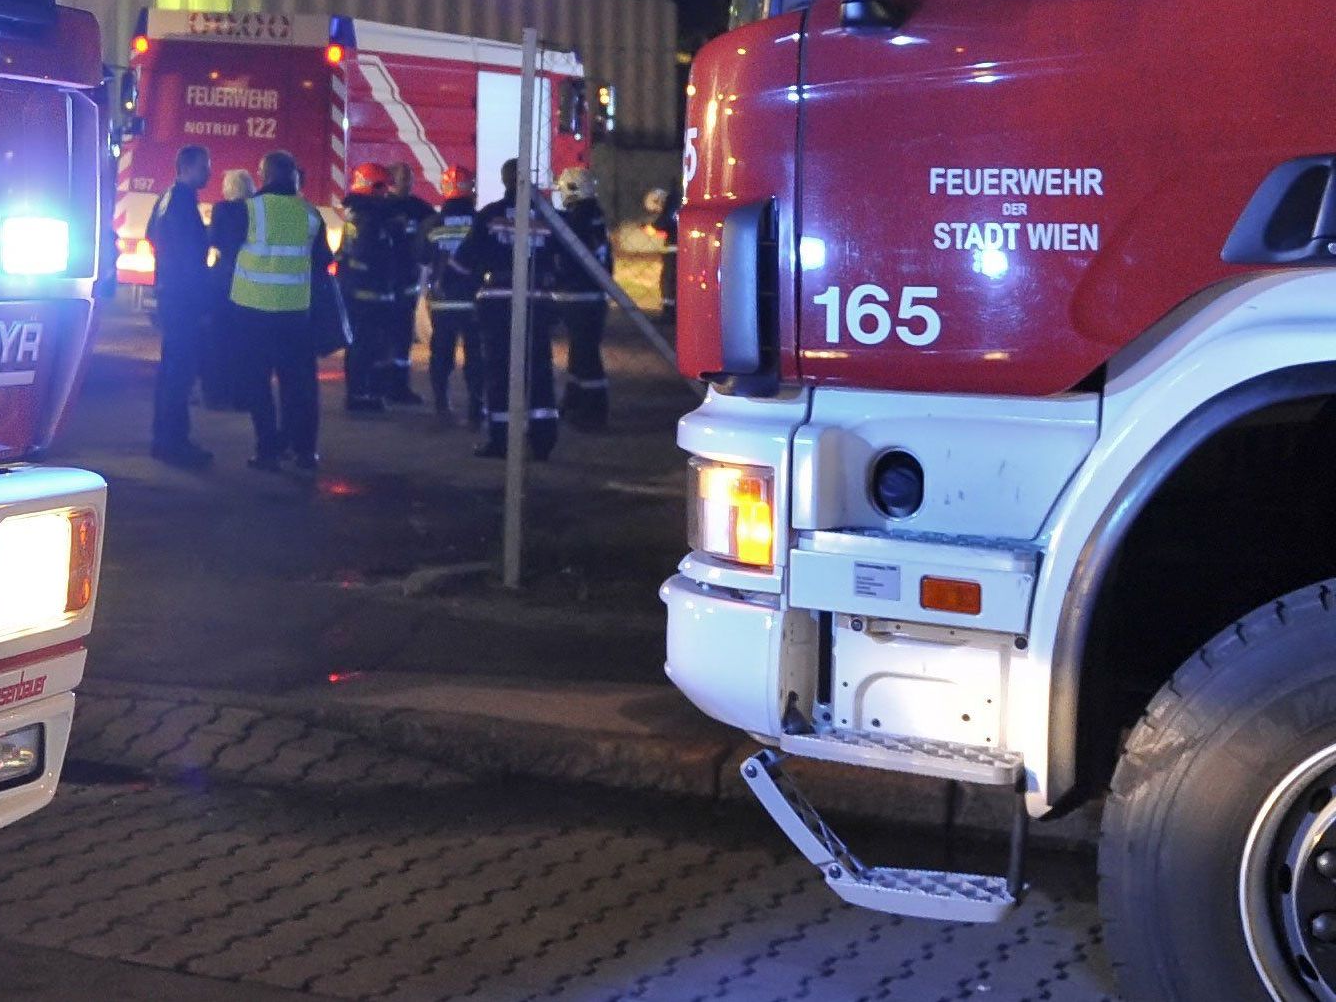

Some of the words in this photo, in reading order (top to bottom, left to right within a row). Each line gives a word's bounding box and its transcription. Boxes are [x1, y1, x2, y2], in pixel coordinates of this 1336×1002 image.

[186, 85, 279, 111] FEUERWEHR
[246, 117, 278, 139] 122
[929, 167, 1104, 196] FEUERWEHR
[1002, 202, 1028, 216] DER
[933, 222, 1021, 250] STADT
[1026, 222, 1099, 251] WIEN
[813, 284, 942, 346] 165
